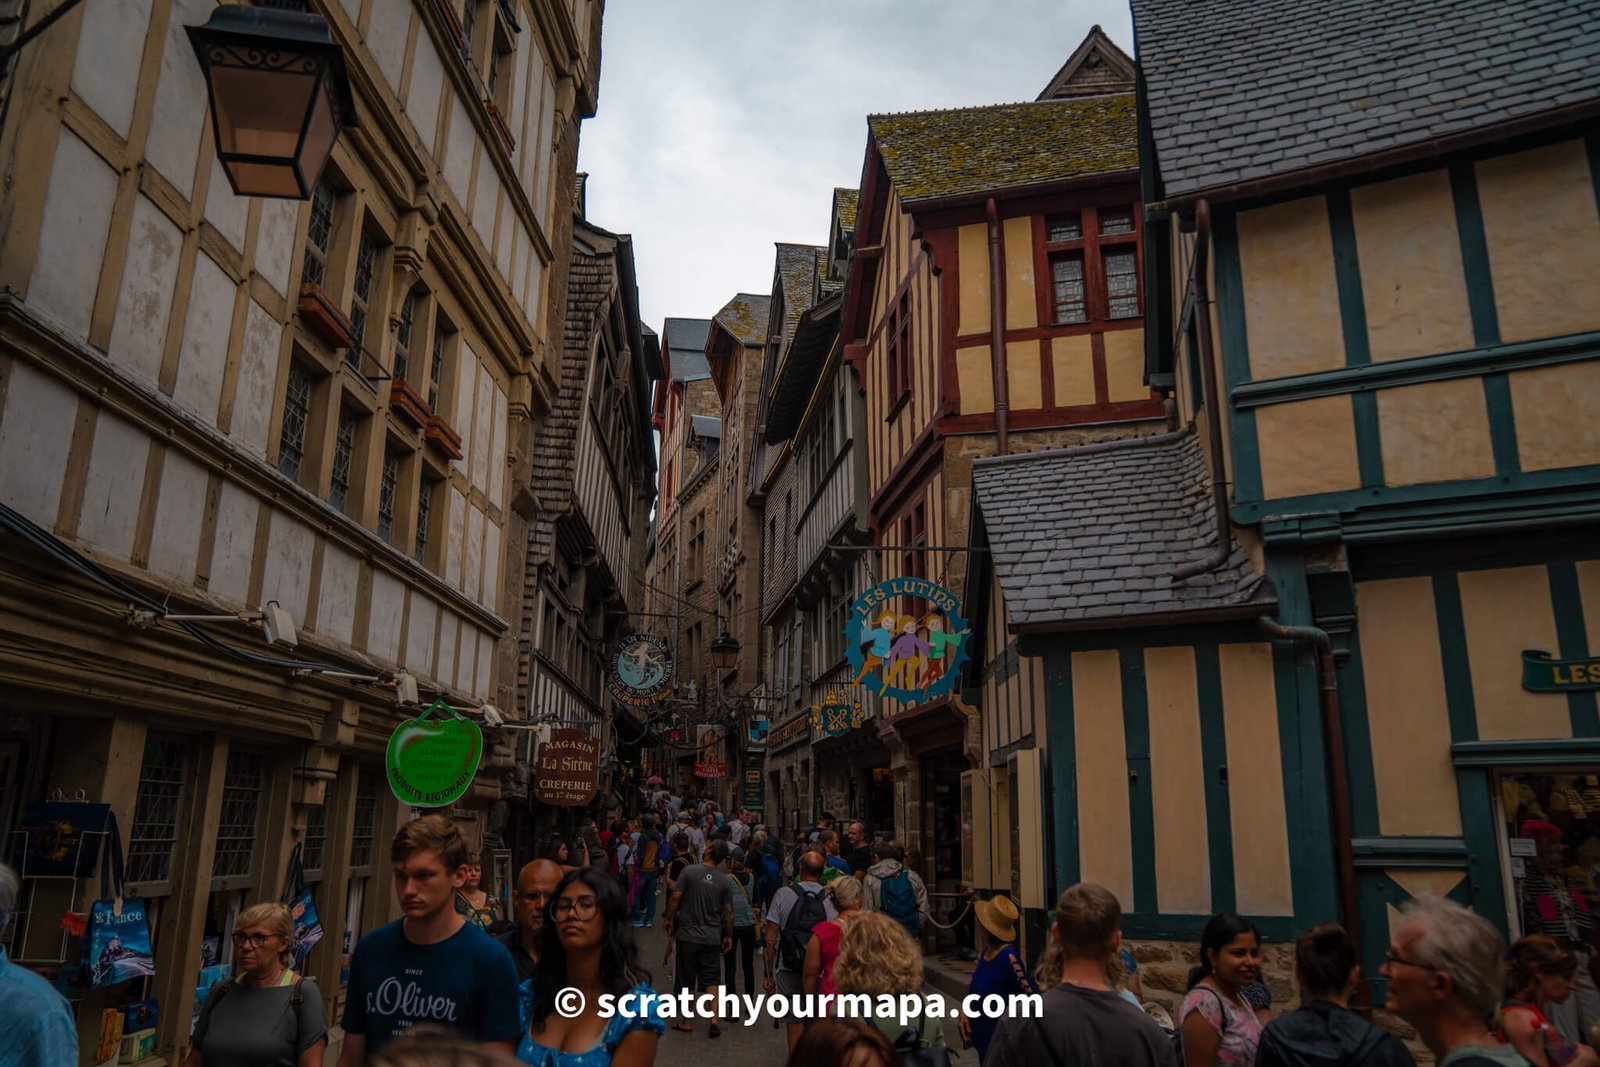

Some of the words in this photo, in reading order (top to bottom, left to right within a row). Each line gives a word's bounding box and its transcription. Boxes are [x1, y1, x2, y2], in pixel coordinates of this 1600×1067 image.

[855, 587, 886, 616] LES
[892, 580, 957, 612] LUTINS
[1552, 663, 1600, 684] LES
[545, 740, 595, 754] MAGASIN
[542, 757, 557, 769] La
[562, 756, 592, 772] Sirène
[390, 768, 422, 800] PRODUITS
[540, 779, 592, 791] CREPERIE
[566, 792, 586, 800] étage
[404, 968, 424, 976] SINCE
[366, 976, 457, 1022] s.Oliver
